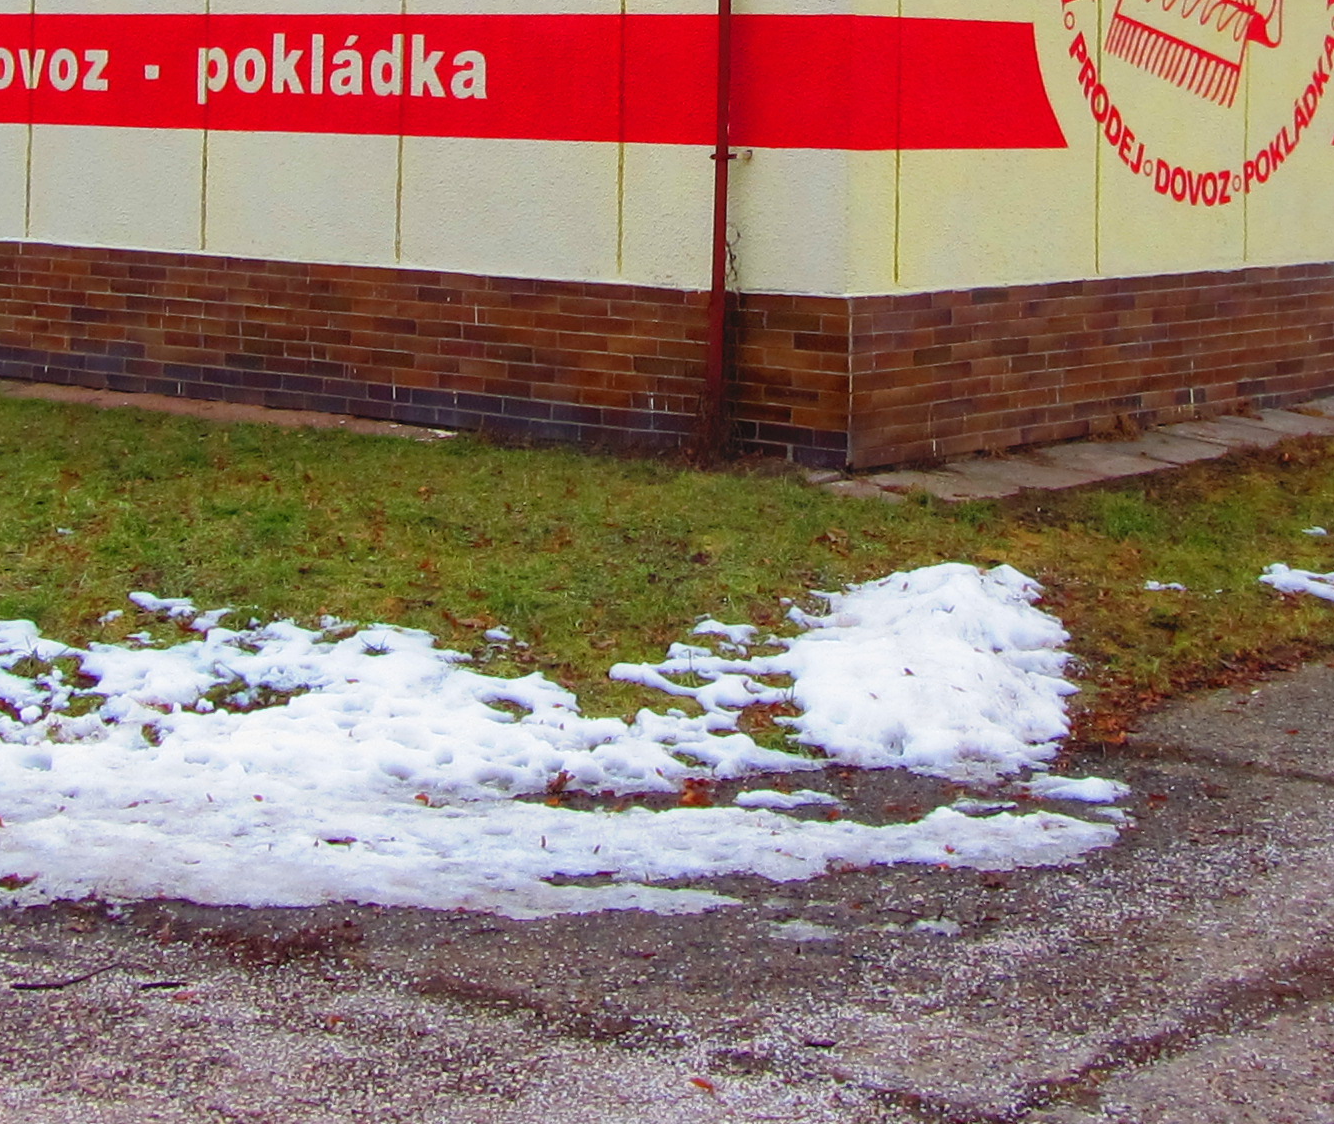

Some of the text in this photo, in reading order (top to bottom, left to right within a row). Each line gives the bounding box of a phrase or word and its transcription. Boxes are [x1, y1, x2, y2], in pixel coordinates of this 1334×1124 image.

[197, 34, 489, 104] pokládka
[1067, 30, 1144, 176] PRODEJ
[1153, 164, 1232, 208] DOVOZ
